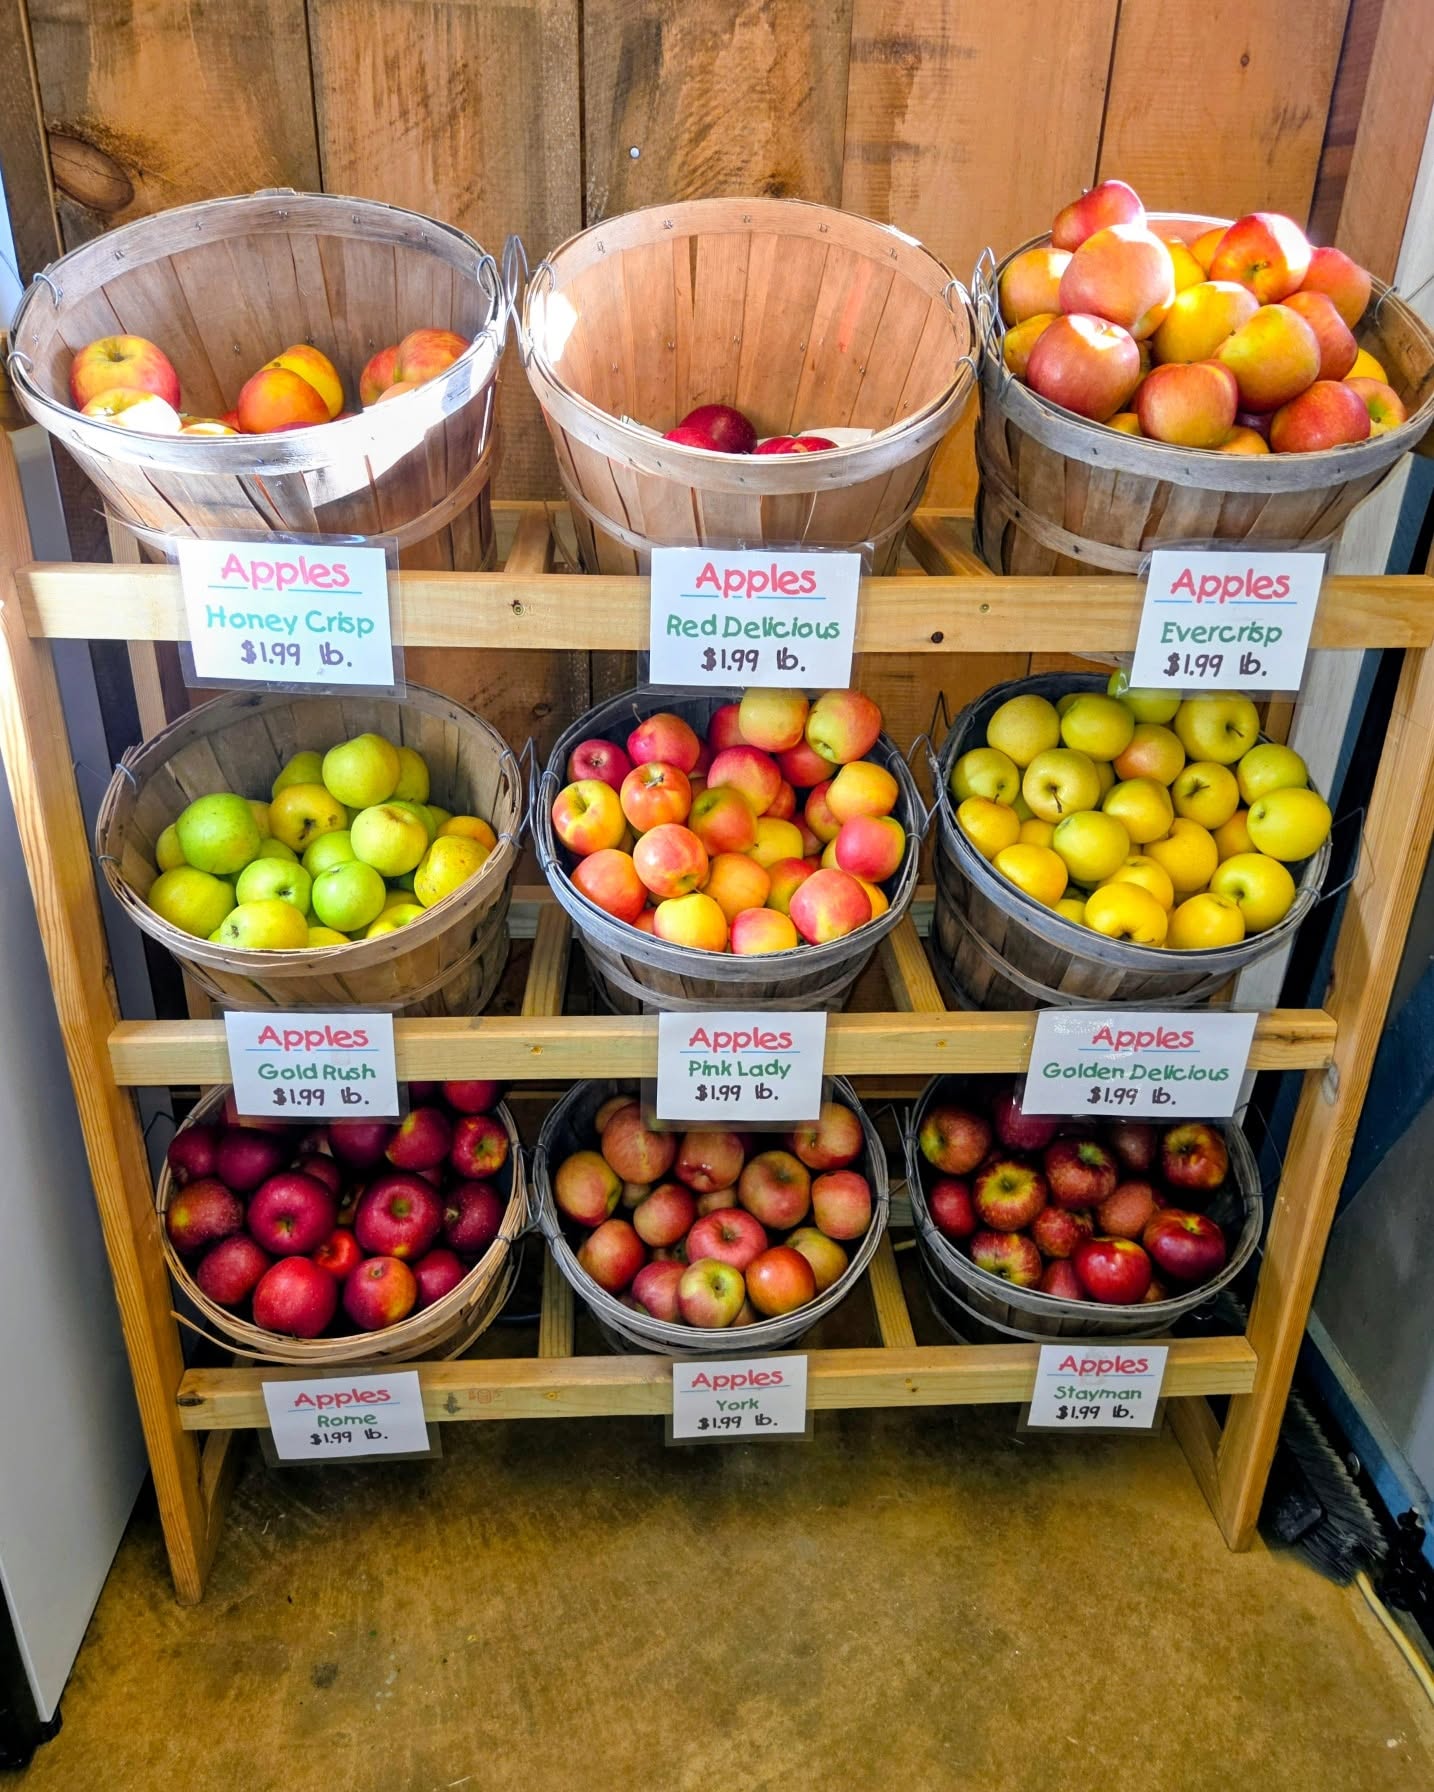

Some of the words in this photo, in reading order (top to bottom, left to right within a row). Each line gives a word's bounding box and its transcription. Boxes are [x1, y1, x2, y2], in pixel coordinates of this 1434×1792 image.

[221, 553, 351, 591] Apples
[695, 562, 817, 599] Apples
[1170, 568, 1291, 604] Apples
[206, 605, 298, 635] Honey
[304, 610, 375, 638] Crisp
[666, 613, 718, 638] Red
[722, 615, 841, 640] Delicious
[1160, 620, 1283, 648] Evercrisp
[240, 639, 301, 667] $1.99
[318, 641, 353, 668] lb.
[700, 646, 760, 672] $1.99
[776, 646, 806, 672] lb.
[1162, 651, 1225, 678] $1.99
[1238, 651, 1268, 677] lb.
[258, 1025, 369, 1051] Apples
[689, 1027, 793, 1053] Apples
[1092, 1027, 1194, 1052] Apples
[257, 1062, 319, 1081] Gold
[322, 1063, 377, 1081] Rush
[688, 1059, 733, 1078] Pink
[736, 1058, 792, 1080] Lady
[1042, 1061, 1125, 1081] Golden
[1128, 1063, 1230, 1082] Delicious
[272, 1087, 326, 1107] $1.99
[340, 1086, 370, 1105] lb.
[694, 1083, 742, 1102] $1.99
[754, 1081, 779, 1101] lb.
[1086, 1085, 1139, 1106] $1.99
[1151, 1086, 1177, 1106] lb.
[1058, 1355, 1149, 1376] Apples
[692, 1369, 784, 1391] Apples
[294, 1389, 391, 1409] Apples
[716, 1398, 759, 1411] York
[1053, 1385, 1142, 1403] Stayman
[317, 1413, 378, 1428] Rome
[697, 1416, 742, 1430] $1.99
[755, 1413, 778, 1426] lb.
[1055, 1404, 1101, 1421] $1.99
[1112, 1403, 1135, 1420] lb.
[309, 1430, 353, 1446] $1.99
[363, 1427, 389, 1440] lb.
